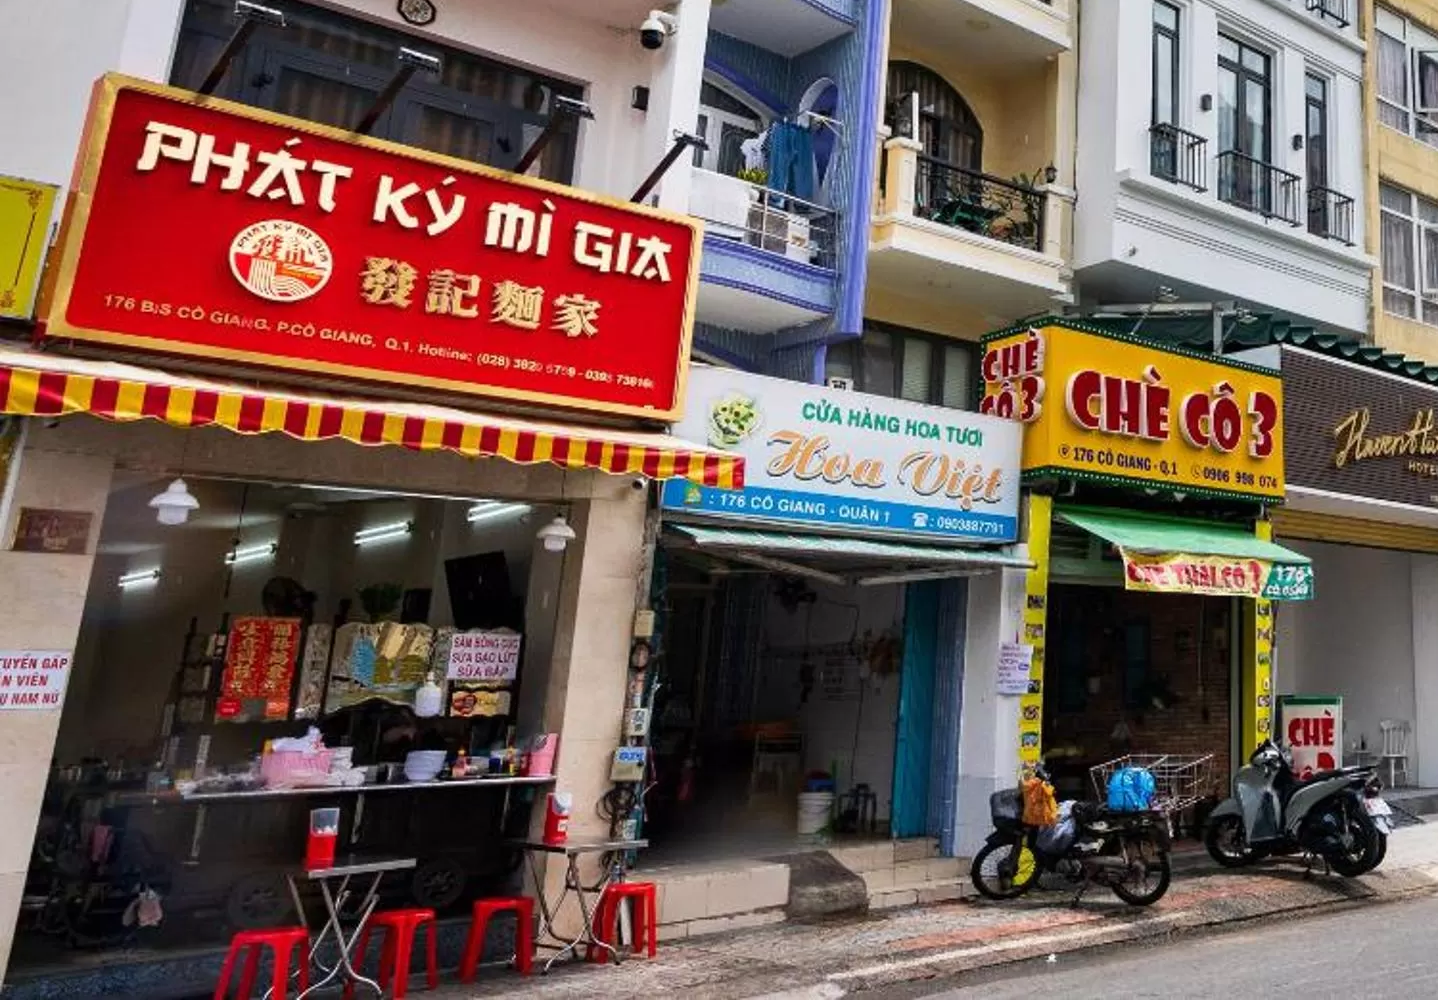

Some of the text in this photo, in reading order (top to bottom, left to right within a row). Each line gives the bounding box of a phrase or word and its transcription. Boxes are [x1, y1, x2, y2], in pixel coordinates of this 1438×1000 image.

[136, 120, 354, 214] PHÁT
[372, 175, 467, 237] KÝ
[573, 220, 673, 283] GIA
[104, 294, 135, 310] 176
[176, 302, 205, 321] CÔ
[477, 353, 510, 370] (028)
[981, 327, 1045, 383] CHÈ
[802, 398, 983, 448] CỬA HÀNG HOA TƯƠI
[980, 373, 1046, 423] CÔ 3
[1066, 364, 1278, 459] CHÈ CÔ 3
[766, 429, 1003, 511] Hoa Việt
[1073, 446, 1094, 462] 176
[1097, 447, 1113, 466] CÔ
[1117, 454, 1151, 471] GIANG
[719, 493, 745, 508] 176
[750, 494, 773, 510] CÔ
[778, 499, 826, 516] GIANG
[17, 671, 49, 686] VIÊN
[1288, 710, 1335, 747] CHÈ
